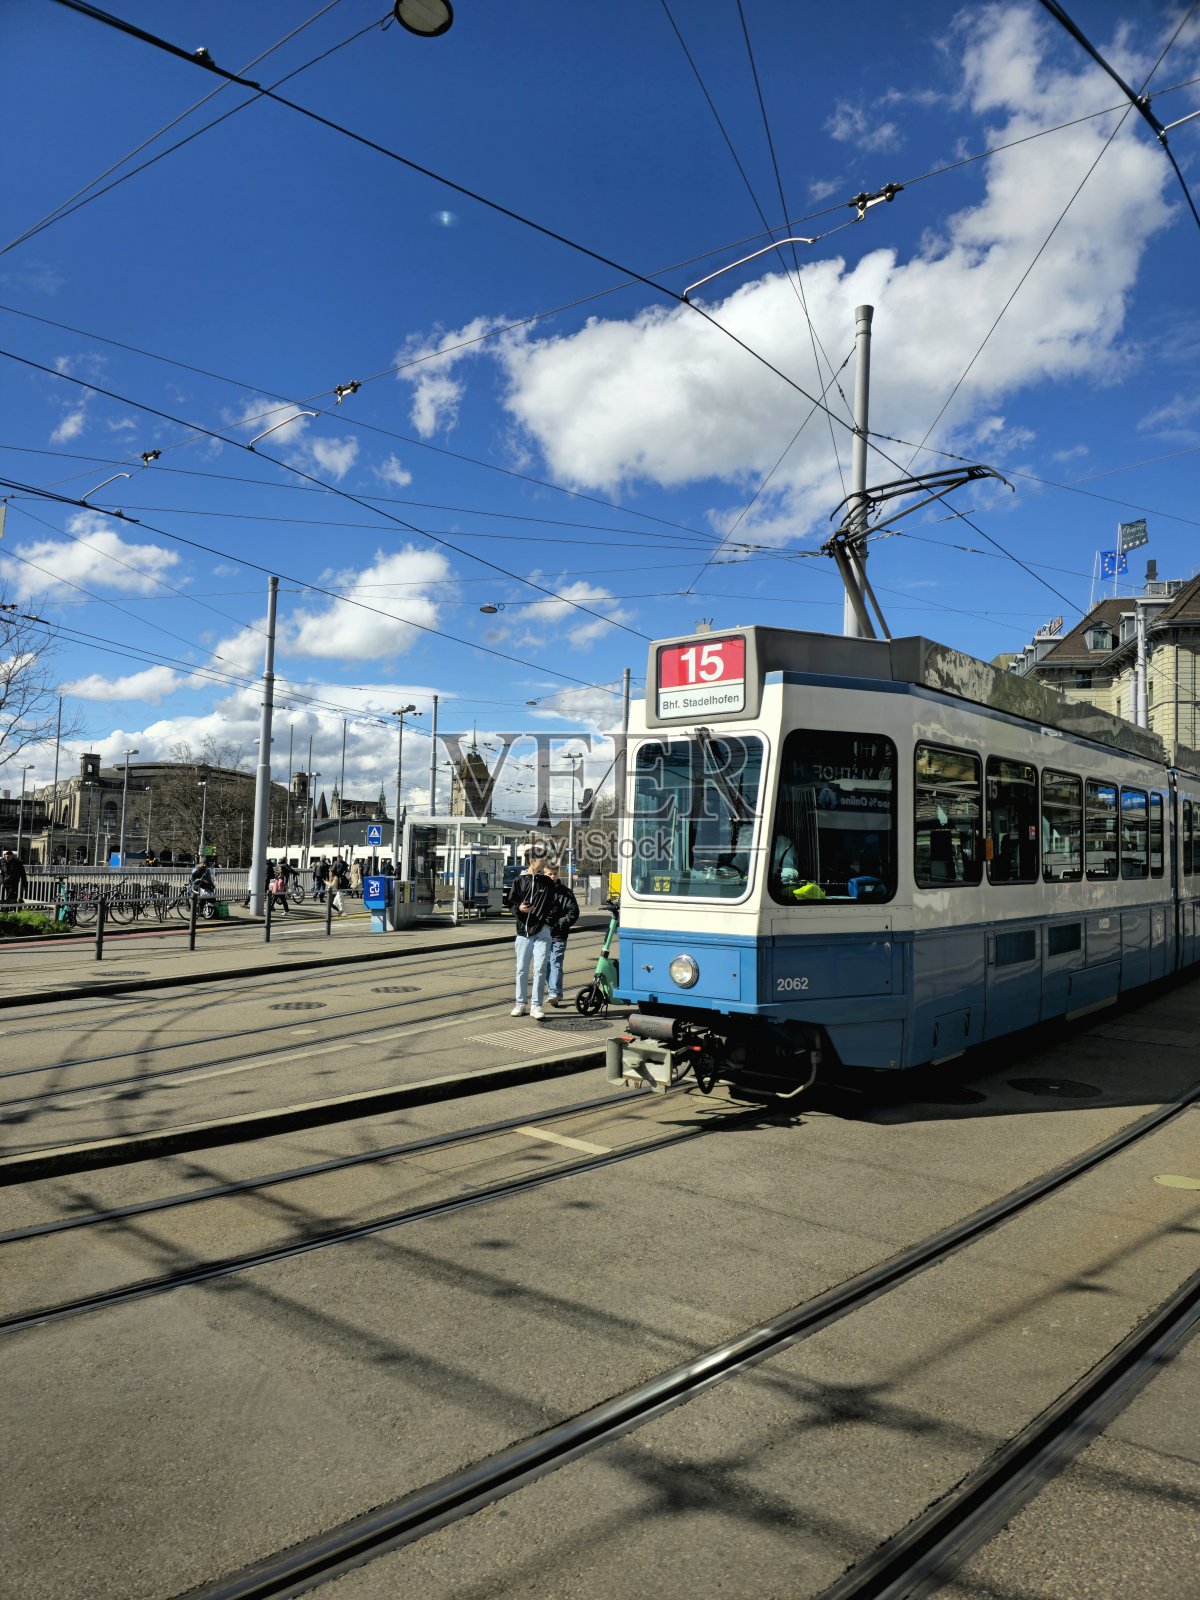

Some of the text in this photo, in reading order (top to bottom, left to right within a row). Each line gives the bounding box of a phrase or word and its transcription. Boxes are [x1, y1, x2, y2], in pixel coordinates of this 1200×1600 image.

[680, 643, 725, 683] 15
[662, 694, 740, 710] Bhf. Stadelhofen
[776, 977, 809, 991] 2062
